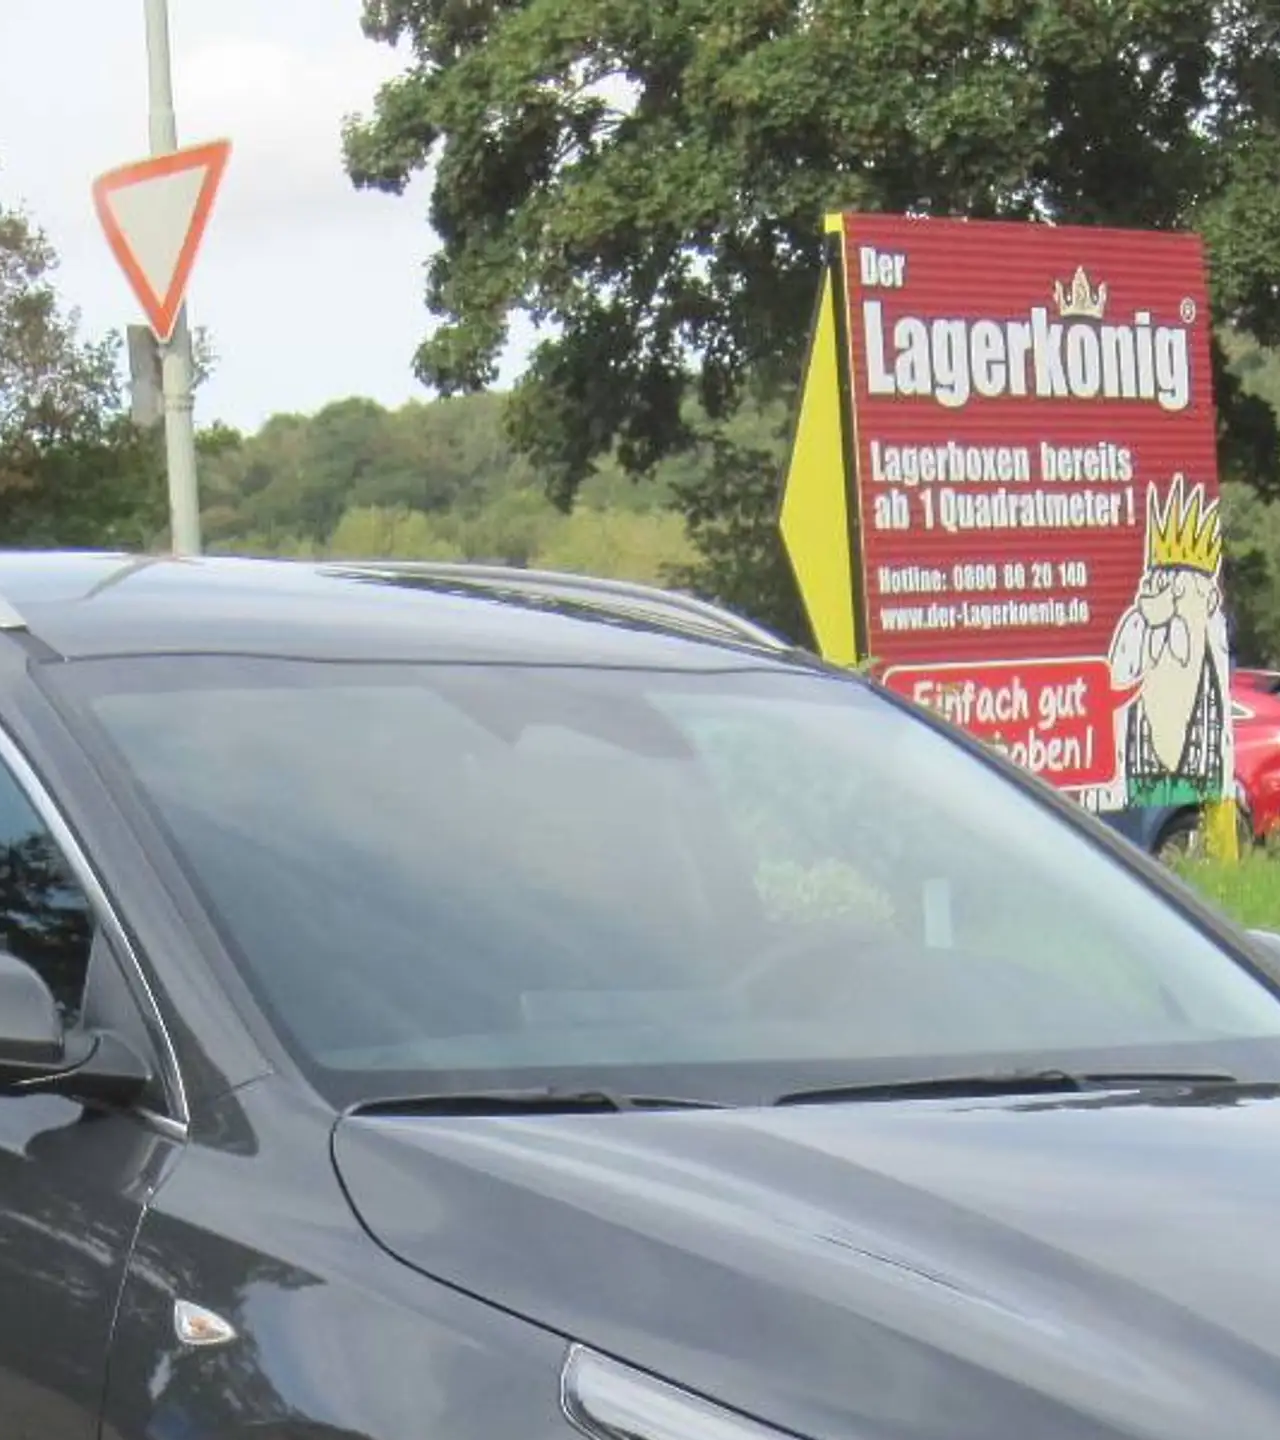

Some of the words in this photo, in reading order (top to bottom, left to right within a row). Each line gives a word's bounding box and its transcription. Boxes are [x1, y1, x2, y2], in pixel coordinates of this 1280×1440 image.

[859, 246, 905, 287] Der
[870, 440, 1031, 486] Lagerboxen
[1040, 440, 1133, 482] bereits
[874, 487, 910, 530] ab
[920, 487, 934, 530] 1
[878, 565, 947, 594] Hotline:
[953, 564, 996, 591] 0800
[1031, 562, 1052, 589] 20
[913, 676, 1030, 724] Einfach
[1037, 676, 1088, 731] gut
